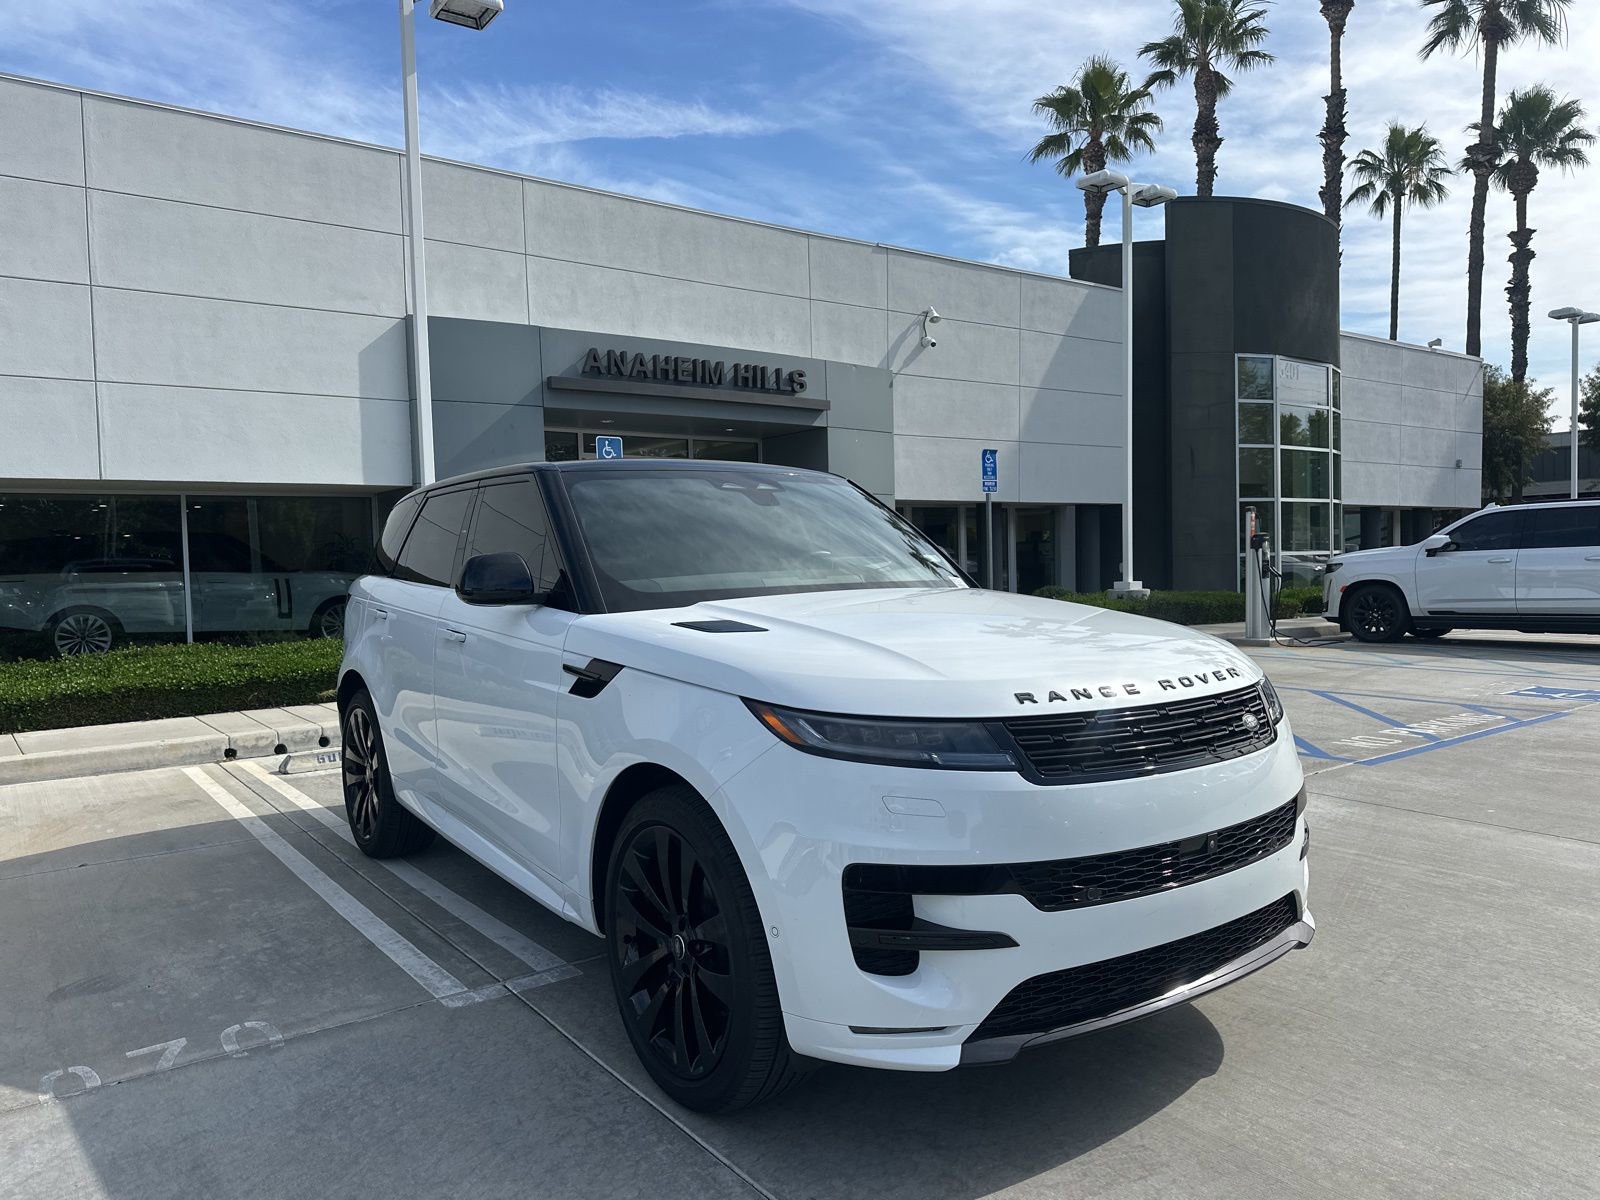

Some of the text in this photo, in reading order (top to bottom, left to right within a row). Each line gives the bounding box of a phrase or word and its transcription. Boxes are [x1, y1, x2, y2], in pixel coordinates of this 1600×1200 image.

[583, 347, 808, 393] ANAHEIM HILLS
[1014, 667, 1242, 705] RANGE ROVER
[1331, 712, 1506, 749] NO PARKING
